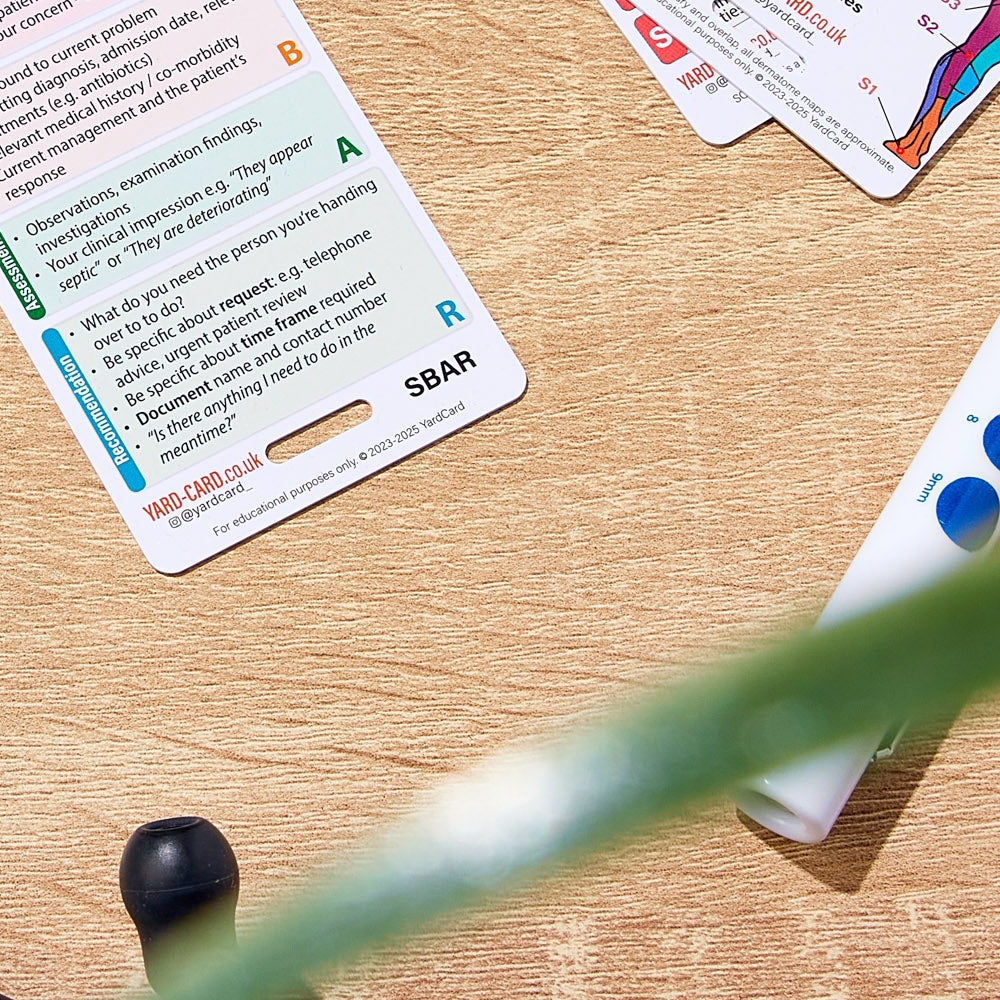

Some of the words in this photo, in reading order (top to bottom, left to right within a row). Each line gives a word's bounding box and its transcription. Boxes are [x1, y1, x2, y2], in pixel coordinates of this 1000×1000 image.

[19, 0, 74, 30] concern
[917, 14, 939, 35] S2
[276, 40, 303, 67] B
[689, 7, 710, 23] and
[707, 21, 740, 50] overlap,
[740, 47, 755, 59] all
[752, 57, 801, 97] dermatome
[800, 95, 826, 117] maps
[825, 115, 841, 129] are
[840, 127, 895, 173] approximate.
[858, 77, 878, 95] S1
[336, 136, 364, 164] A
[25, 187, 119, 236] Observations,
[120, 145, 203, 191] examination
[202, 117, 262, 150] findings,
[435, 300, 466, 328] R
[135, 380, 214, 426] Document
[213, 362, 254, 388] name
[253, 343, 282, 367] and
[282, 319, 335, 352] contact
[334, 292, 388, 327] number
[404, 350, 477, 398] SBAR
[59, 354, 129, 466] Recommendation
[966, 414, 979, 423] 8
[142, 451, 264, 522] YARD-CARD.co.uk
[916, 472, 944, 503] 9mm
